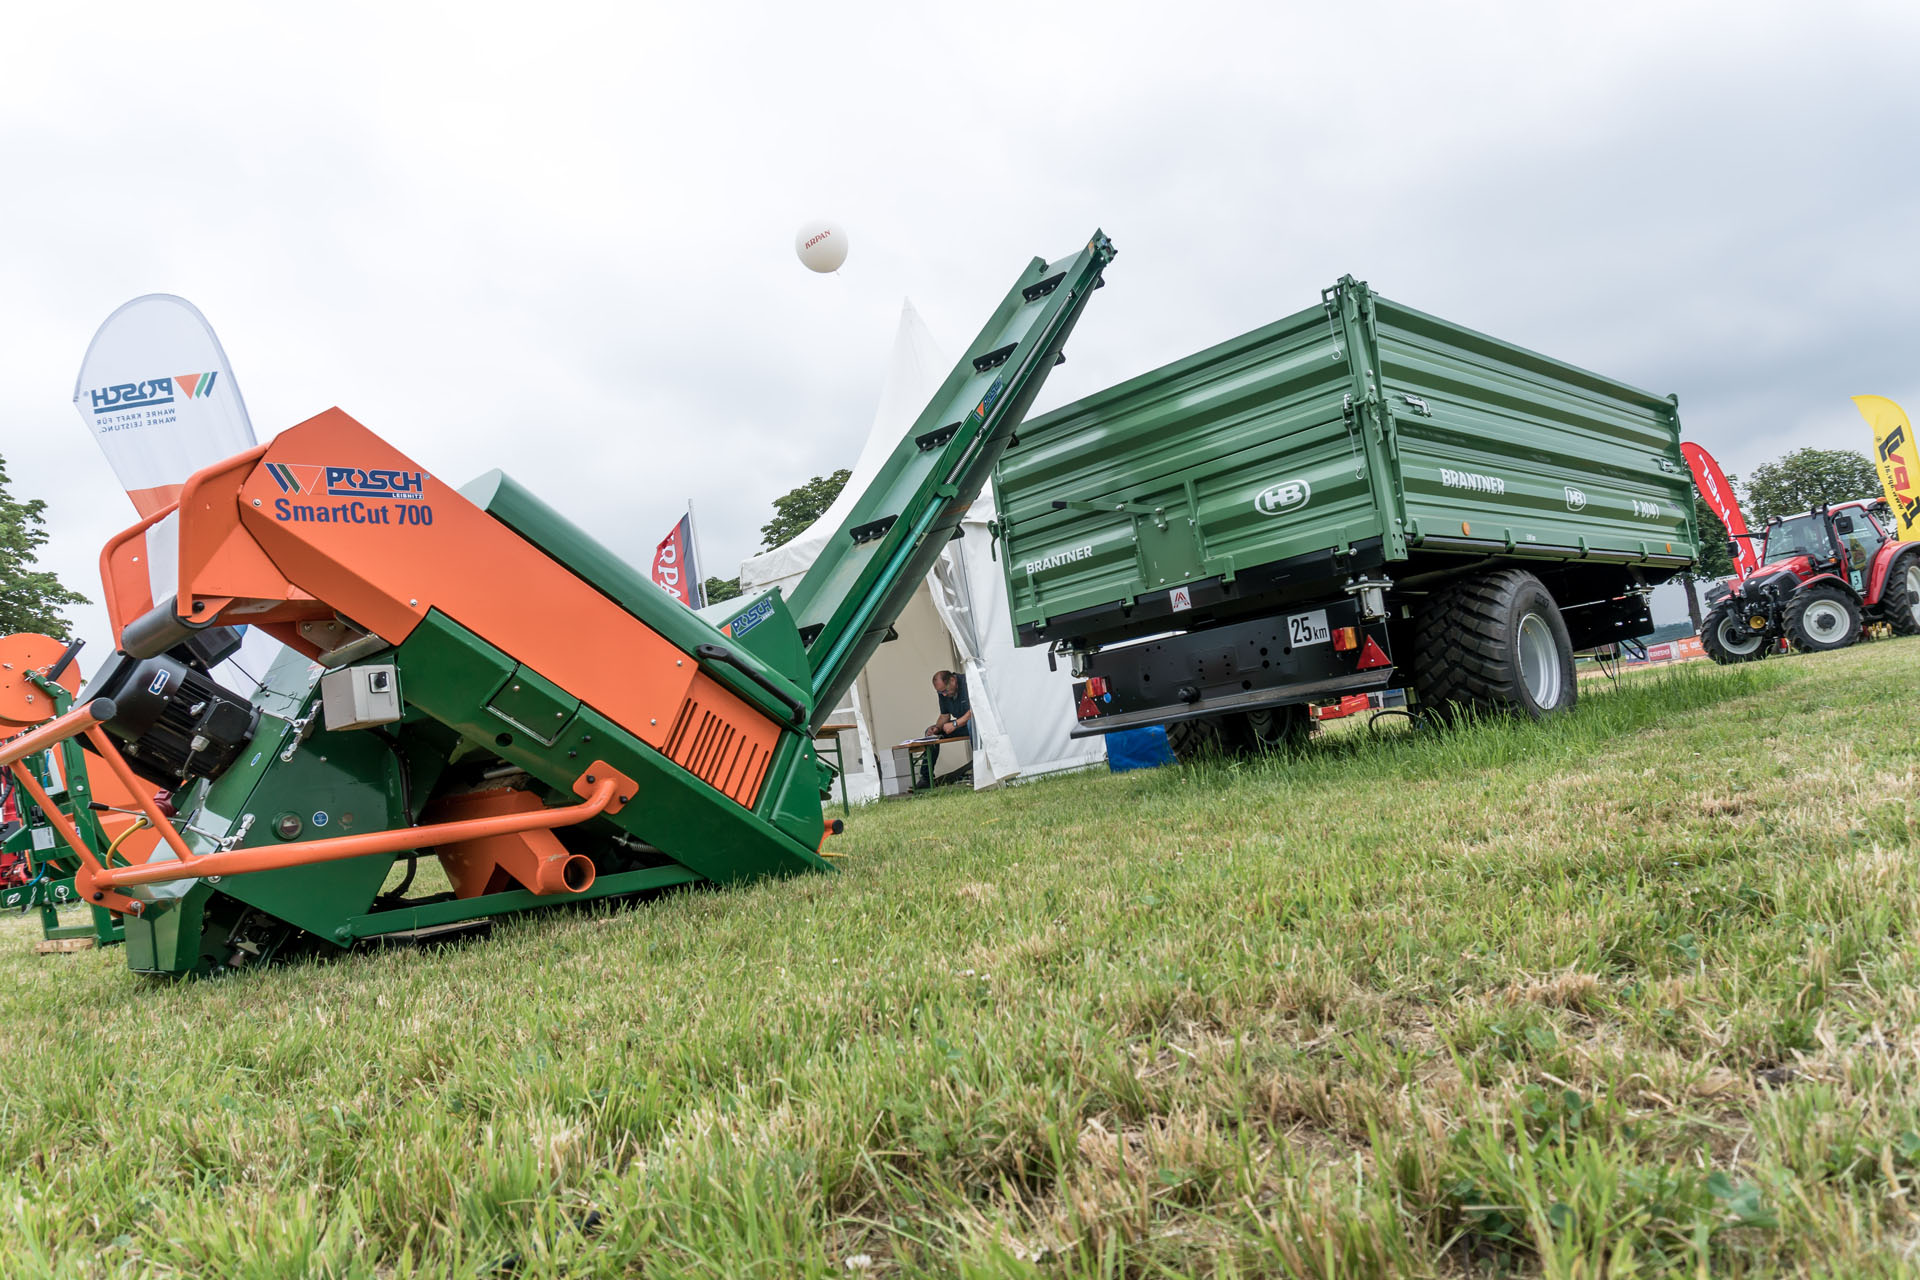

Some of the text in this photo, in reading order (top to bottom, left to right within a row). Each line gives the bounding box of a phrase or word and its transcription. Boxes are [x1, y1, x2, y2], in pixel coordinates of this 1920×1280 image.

[804, 229, 831, 249] KRPAN
[325, 466, 424, 492] POSCH
[1439, 468, 1505, 495] BRANTNER
[391, 492, 424, 500] LEIBNITZ
[1263, 484, 1303, 511] HB
[1567, 488, 1584, 506] HB
[274, 498, 433, 526] SmartCut 700
[1025, 545, 1093, 575] BRANTNER
[731, 597, 773, 633] POSCH
[1290, 616, 1328, 644] 25 km
